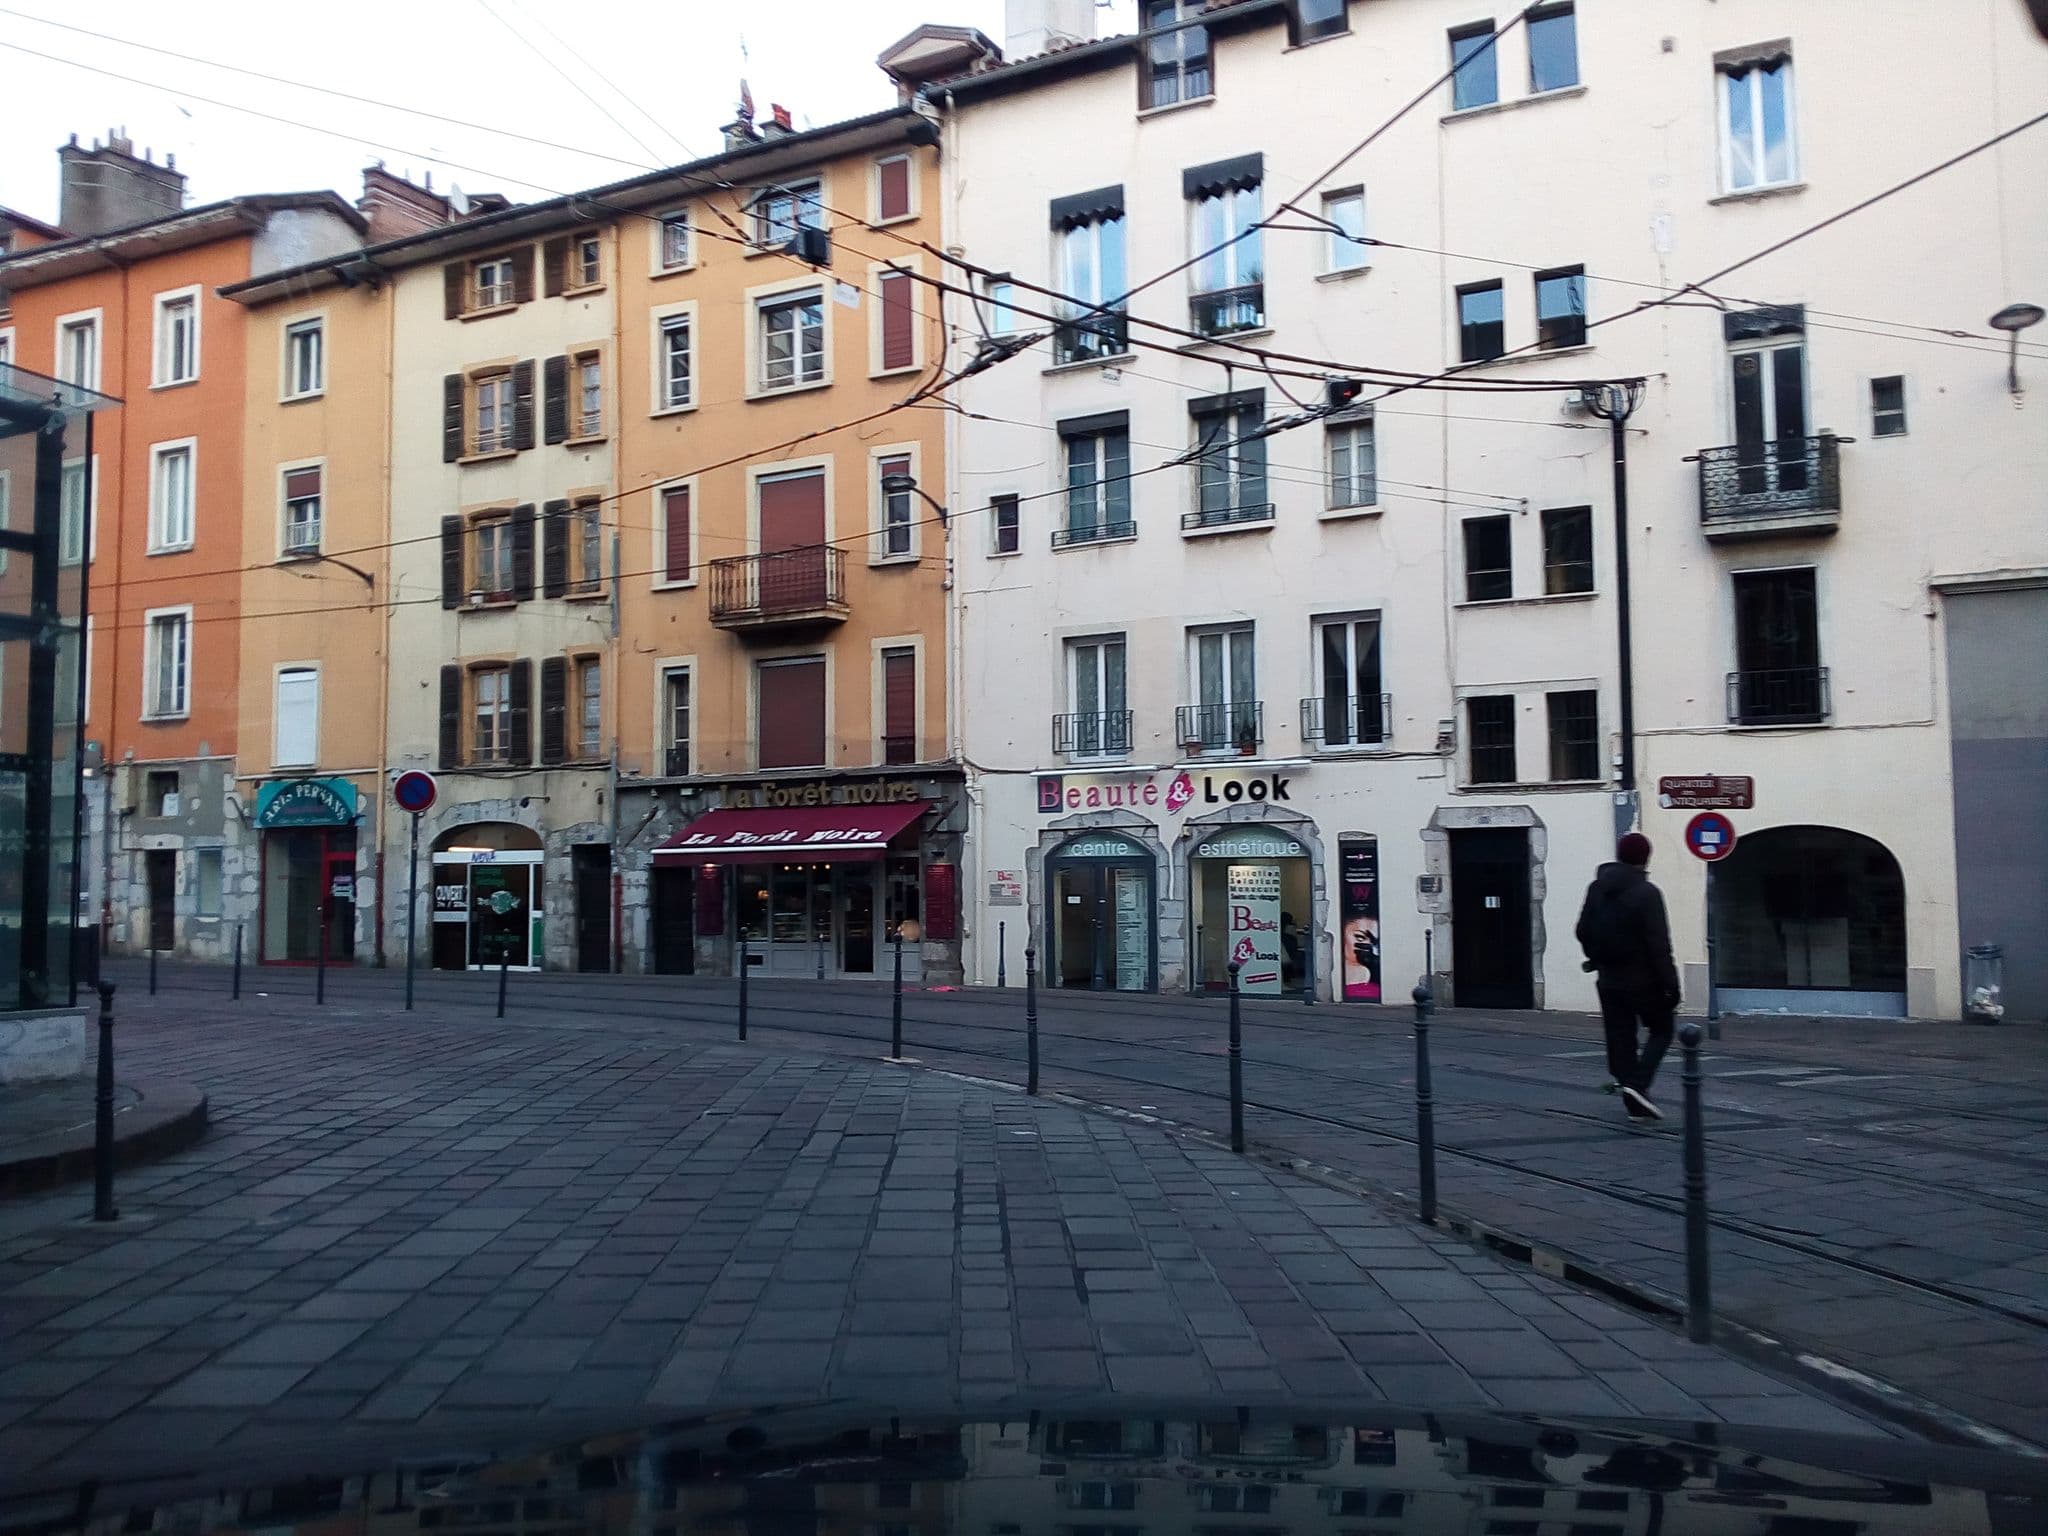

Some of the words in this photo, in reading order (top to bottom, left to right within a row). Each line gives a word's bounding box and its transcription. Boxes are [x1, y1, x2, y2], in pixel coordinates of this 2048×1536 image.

[719, 784, 748, 808] La
[761, 780, 833, 807] Forêt
[842, 777, 919, 803] noire
[1039, 775, 1159, 809] Beauté
[1172, 780, 1189, 801] &
[1203, 774, 1290, 803] Look
[680, 833, 718, 846] La
[724, 829, 800, 845] Forêt
[802, 827, 884, 843] Noire
[1071, 841, 1129, 856] centre
[1199, 840, 1301, 857] esthétique
[1255, 951, 1280, 961] Look
